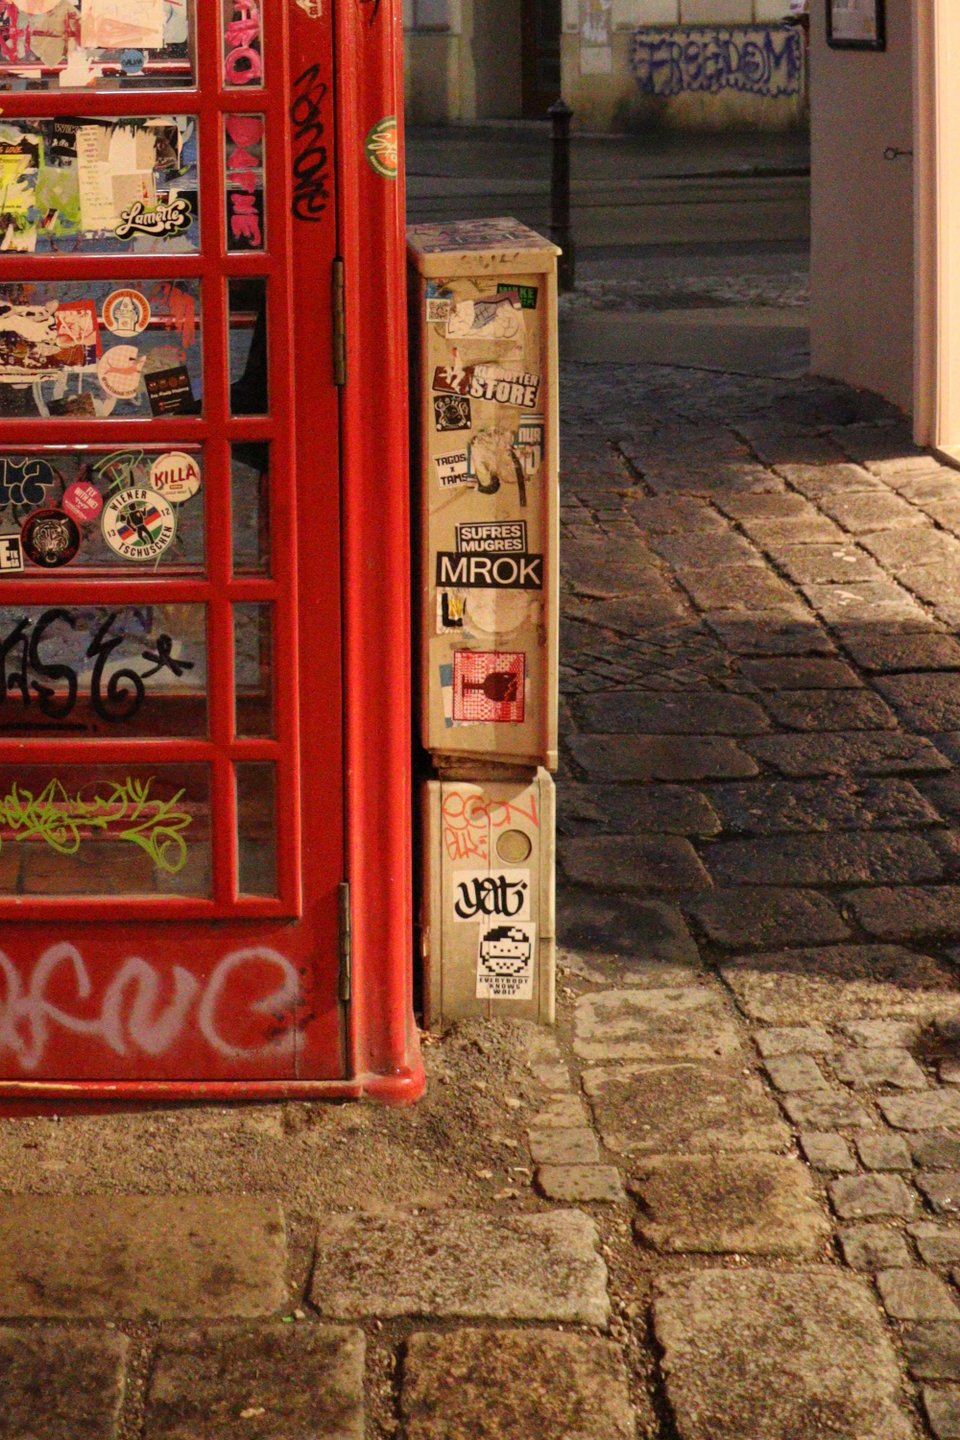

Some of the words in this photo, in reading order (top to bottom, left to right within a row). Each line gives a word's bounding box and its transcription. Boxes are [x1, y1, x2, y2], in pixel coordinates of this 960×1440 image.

[118, 200, 186, 235] Lamette
[469, 376, 537, 408] STORE
[154, 463, 197, 487] KILLA
[110, 490, 147, 511] WIENER
[161, 507, 171, 517] 12
[107, 529, 116, 538] 13
[118, 525, 173, 557] TSCHUSCHEN
[461, 525, 522, 539] SUFRES
[461, 539, 522, 552] MUGRES
[440, 556, 541, 585] MROK
